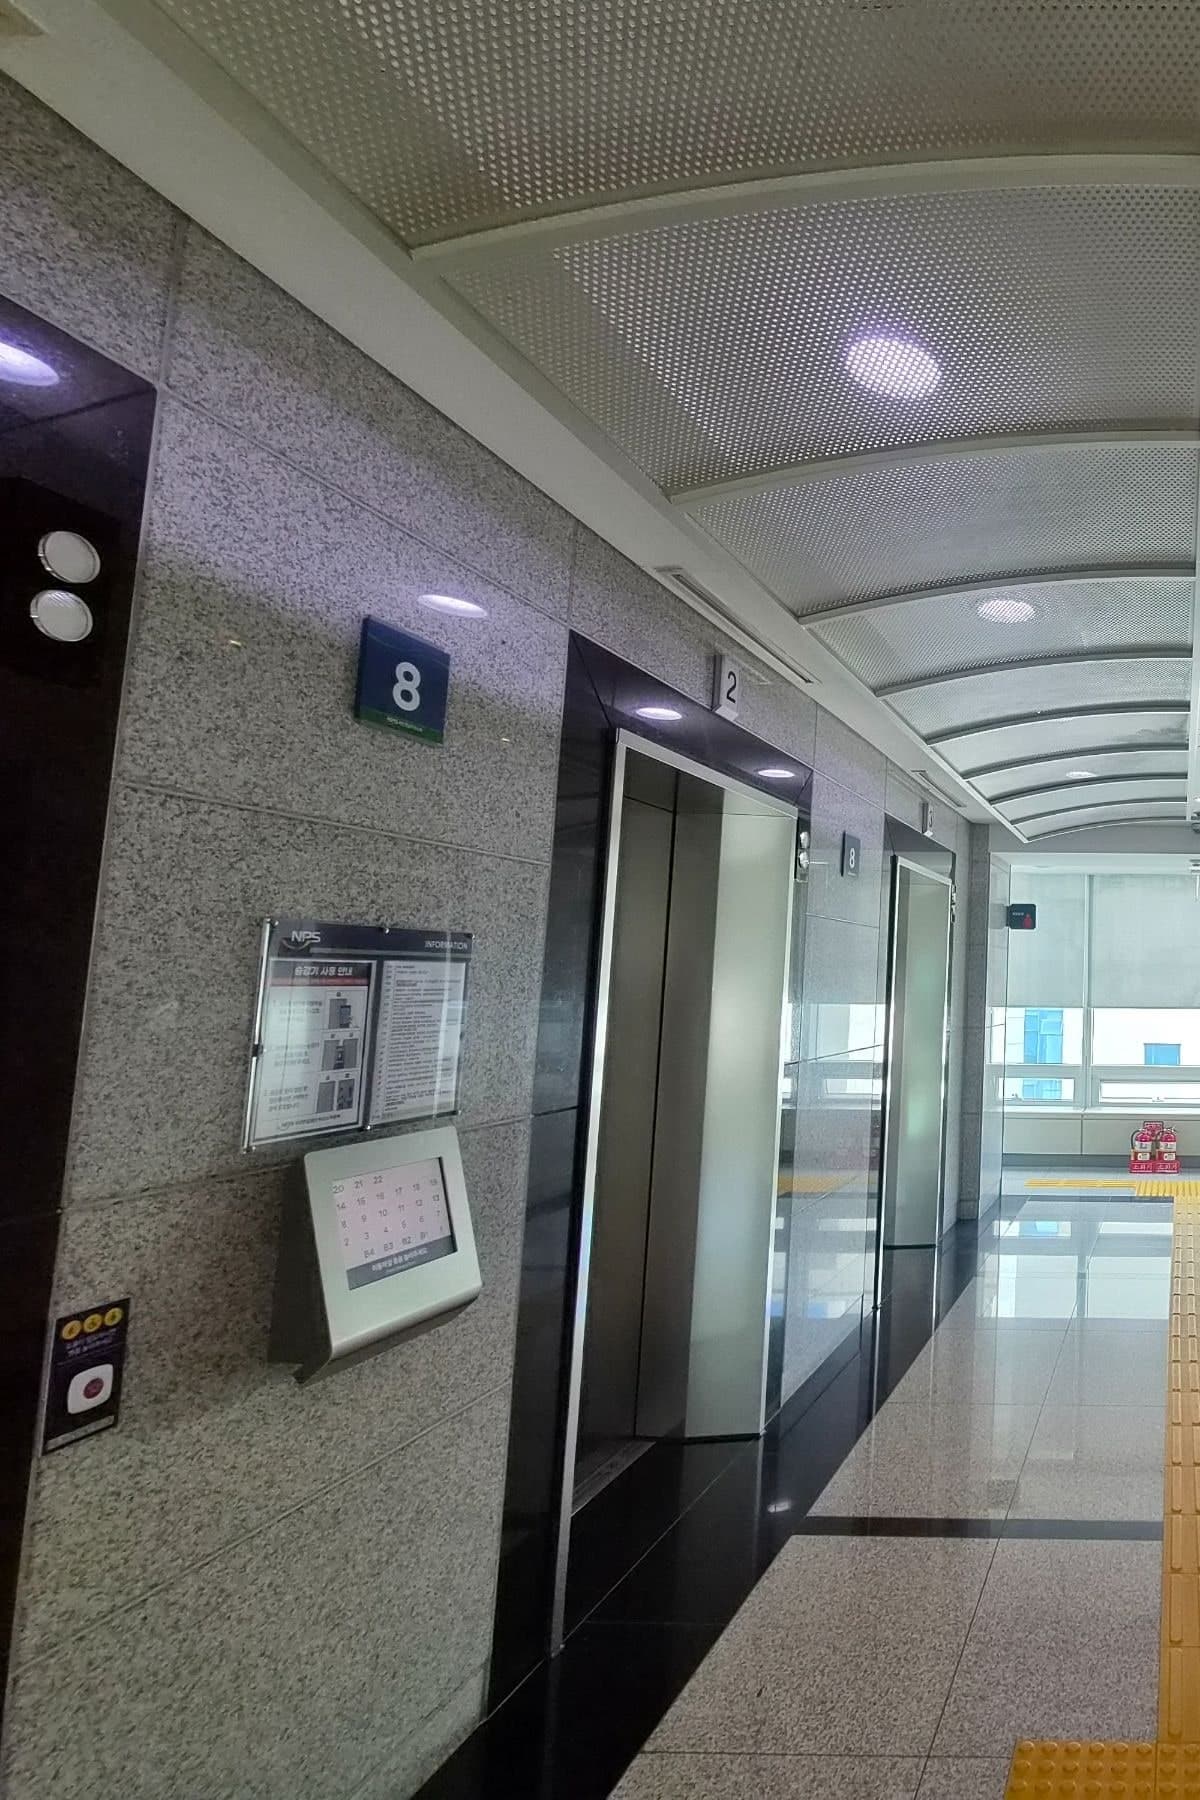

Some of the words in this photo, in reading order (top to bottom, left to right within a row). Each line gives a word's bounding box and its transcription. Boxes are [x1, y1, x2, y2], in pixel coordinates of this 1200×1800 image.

[392, 661, 421, 711] 8
[726, 671, 737, 703] 2
[849, 848, 856, 869] 8
[291, 930, 321, 943] NPS
[424, 940, 468, 950] INFORMATION
[332, 1185, 345, 1194] 20
[373, 1176, 383, 1185] 22
